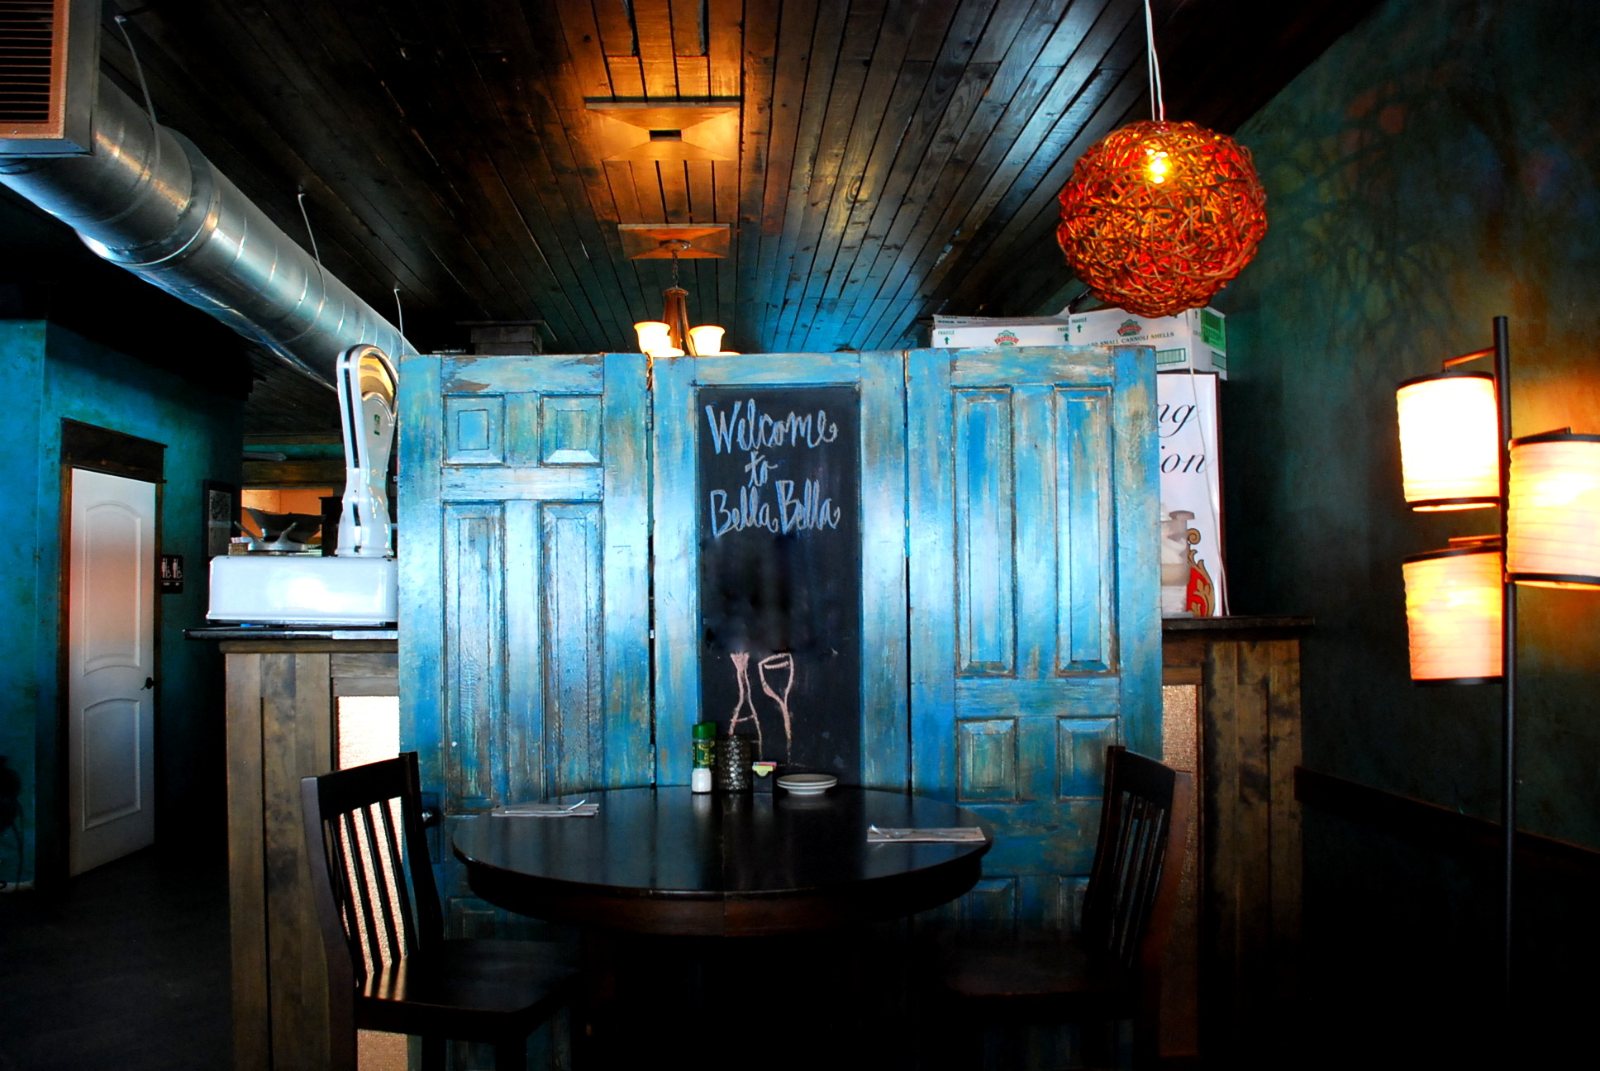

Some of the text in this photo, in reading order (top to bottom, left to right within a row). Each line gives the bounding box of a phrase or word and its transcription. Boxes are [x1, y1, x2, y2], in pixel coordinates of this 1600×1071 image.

[704, 398, 838, 454] Welcome
[744, 451, 778, 488] to
[710, 478, 841, 538] Bella Bella
